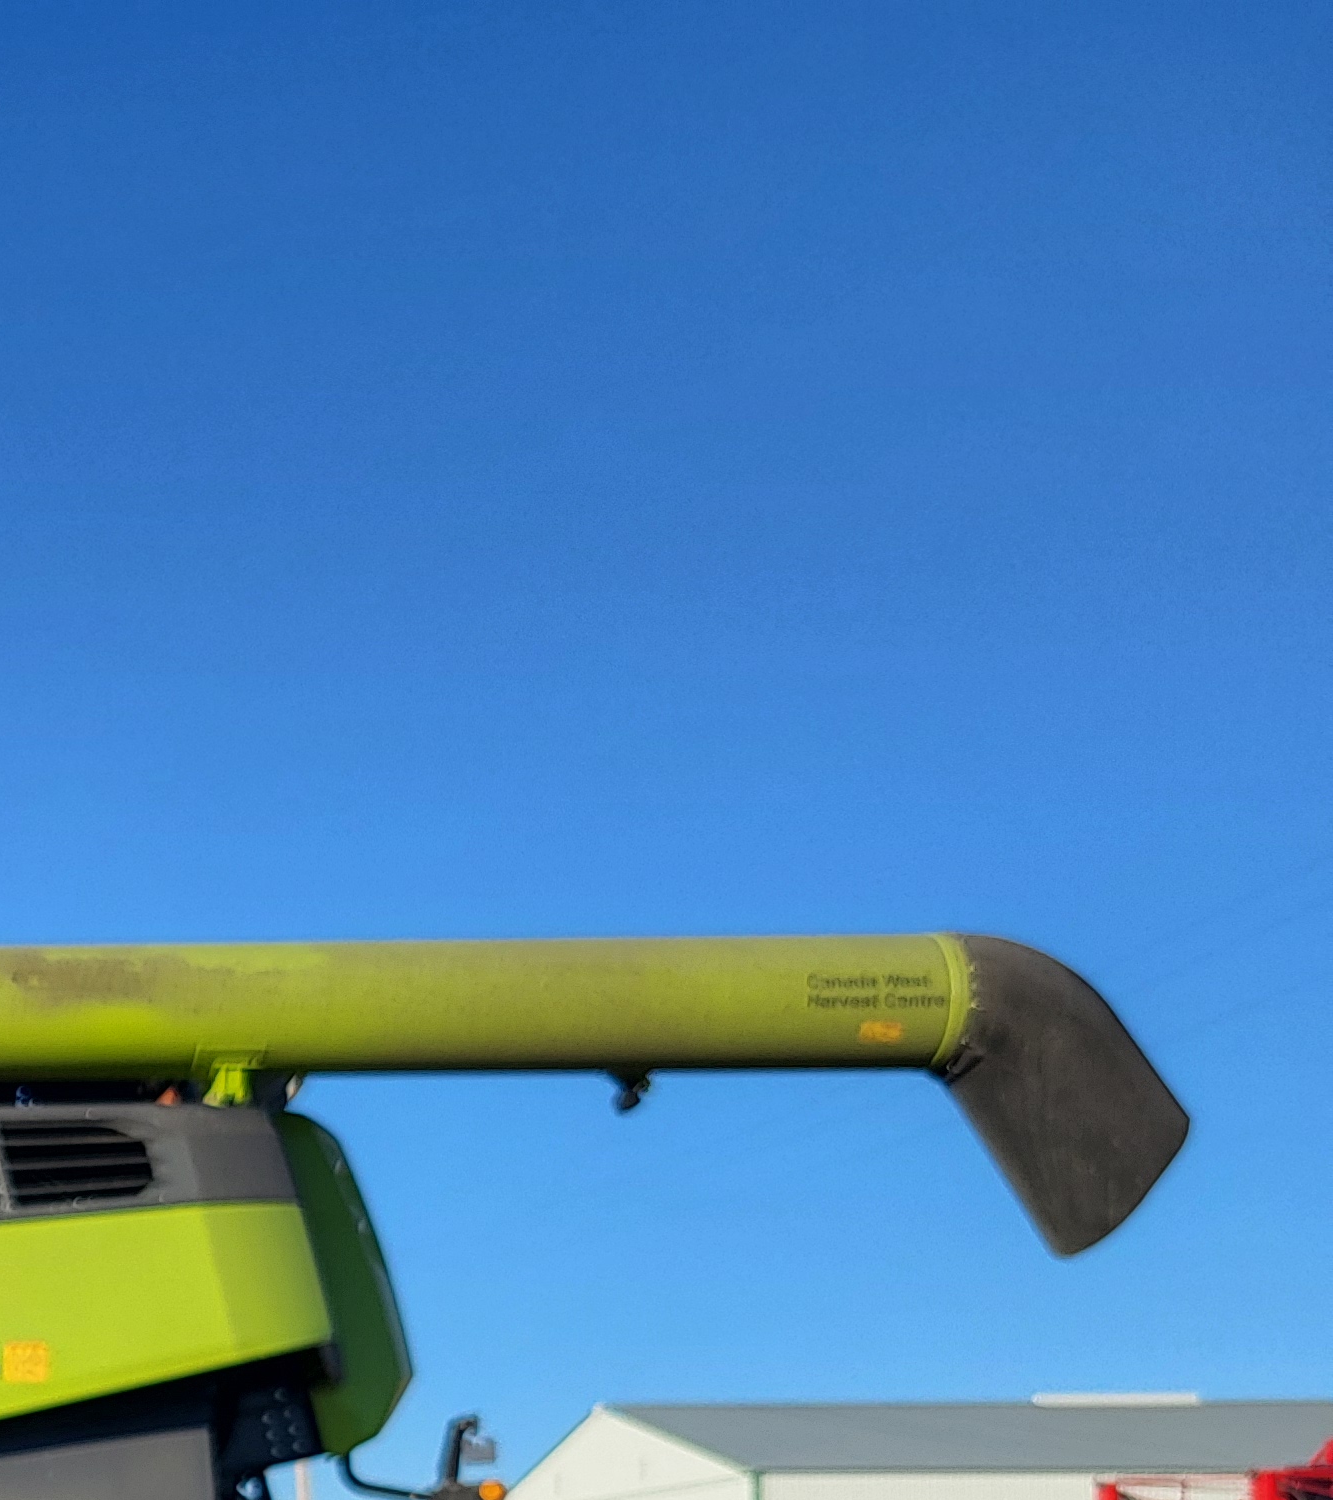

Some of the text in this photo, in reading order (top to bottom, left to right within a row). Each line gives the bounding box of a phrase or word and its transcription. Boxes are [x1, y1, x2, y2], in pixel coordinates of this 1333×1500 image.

[807, 972, 932, 989] Canada West
[806, 993, 945, 1009] Harvest Centre
